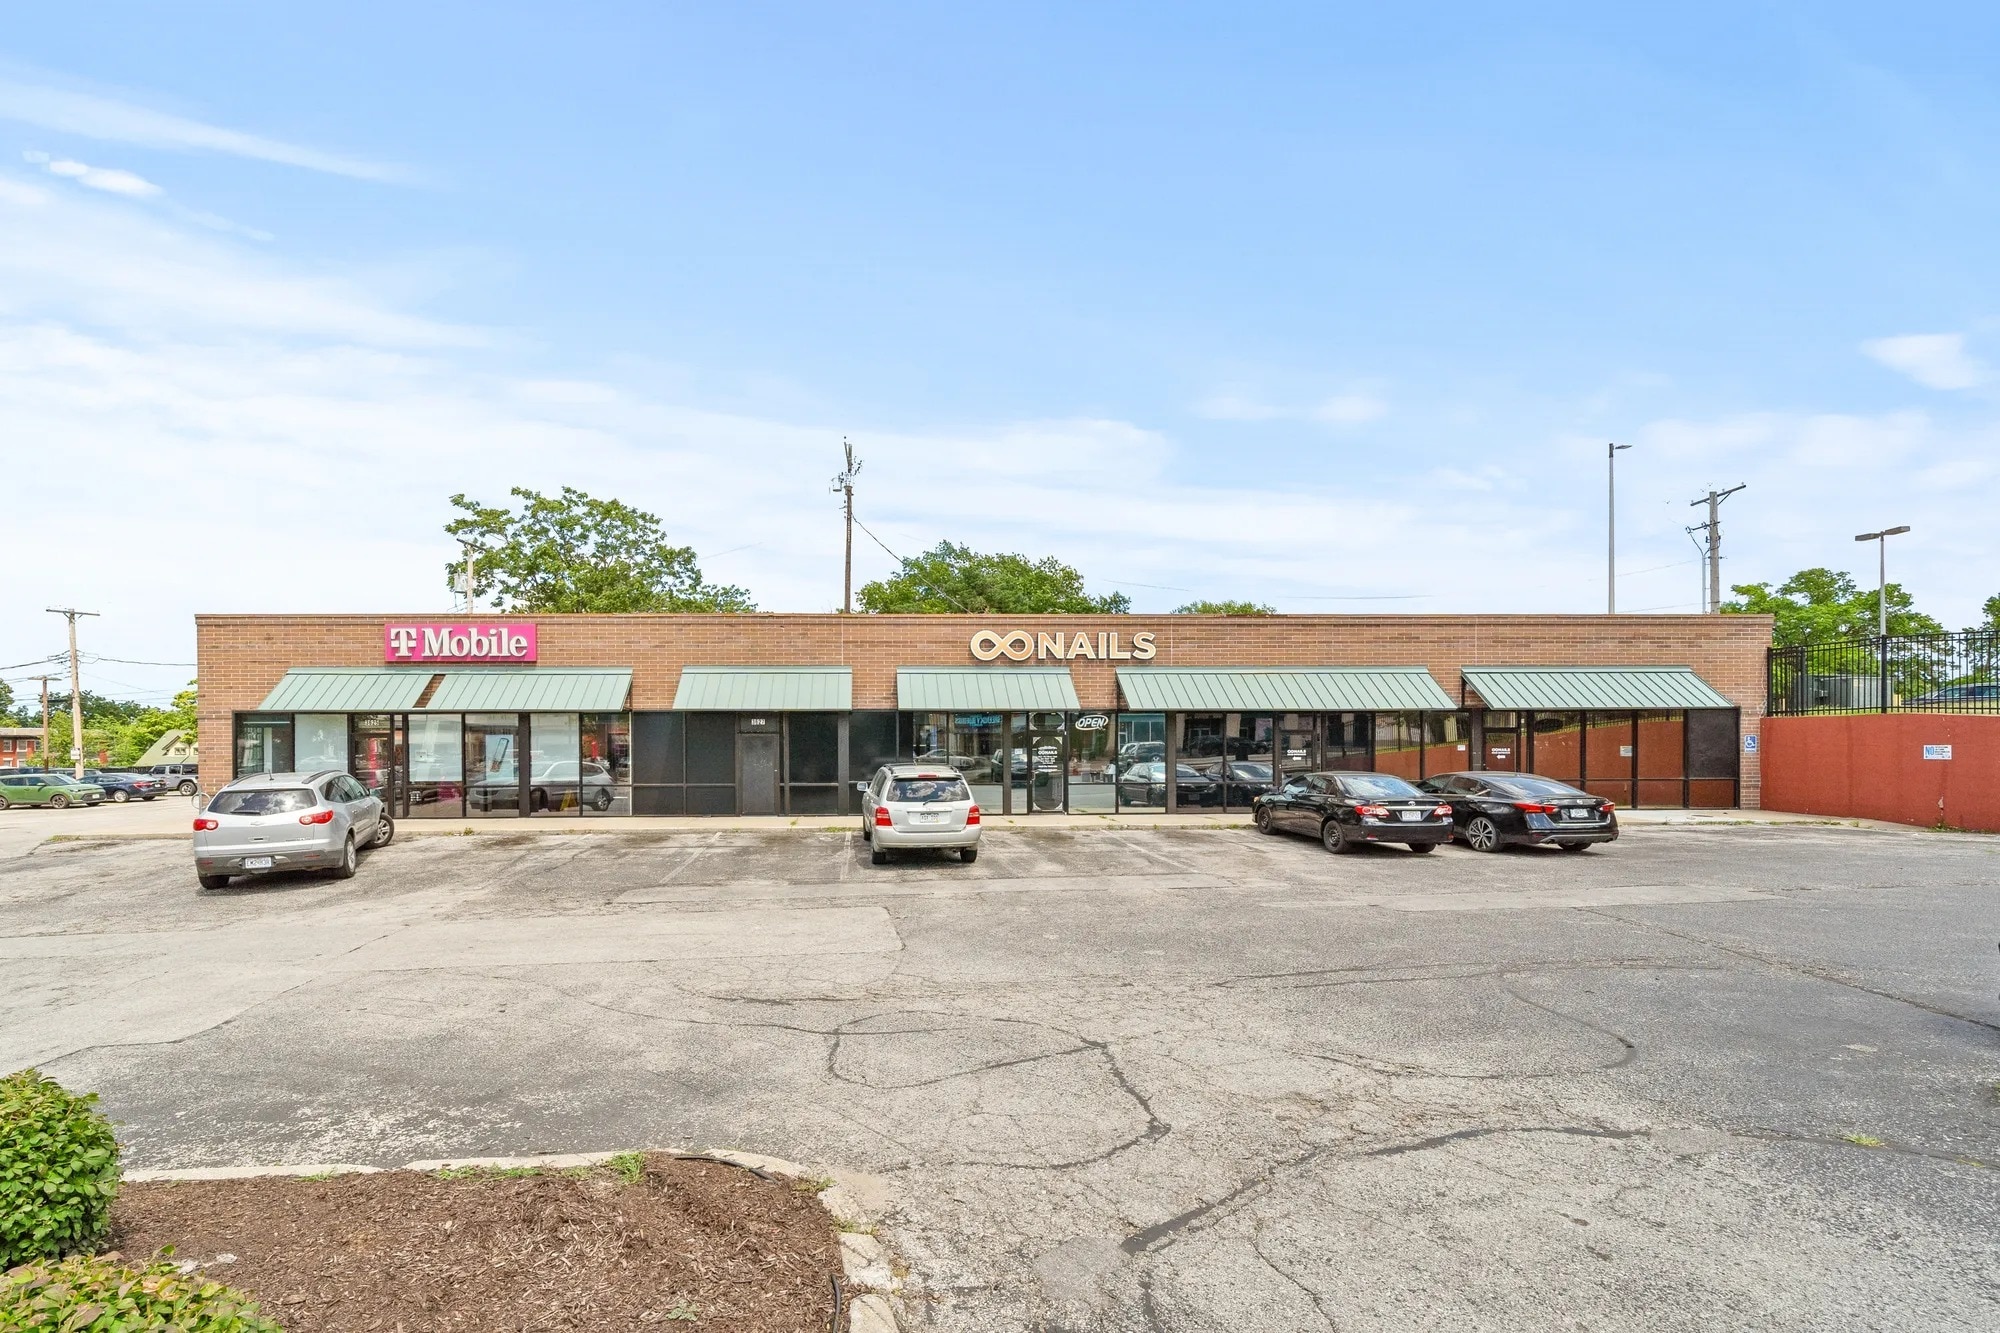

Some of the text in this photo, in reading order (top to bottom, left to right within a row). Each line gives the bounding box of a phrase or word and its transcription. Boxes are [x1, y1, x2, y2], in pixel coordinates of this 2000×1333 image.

[390, 627, 528, 657] T Mobile
[1037, 631, 1157, 660] NAILS
[1078, 717, 1105, 728] OPEN
